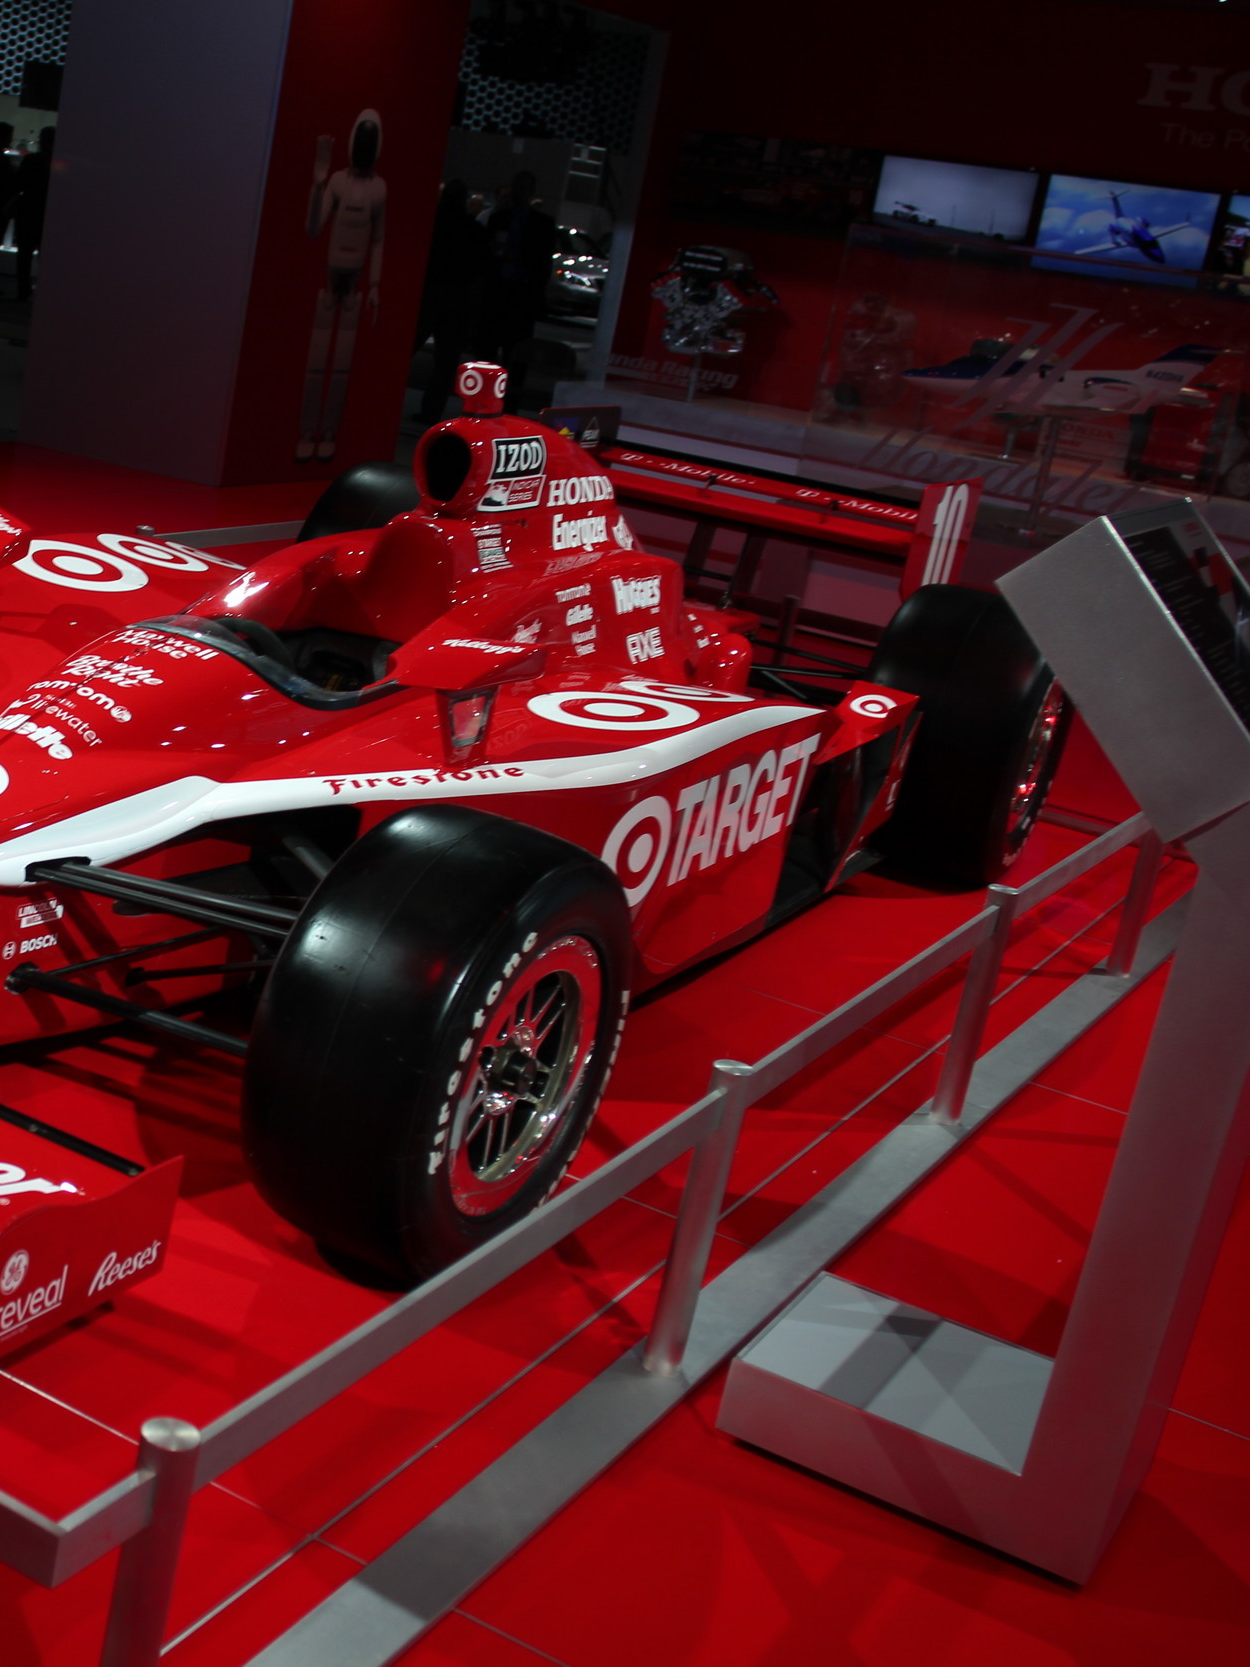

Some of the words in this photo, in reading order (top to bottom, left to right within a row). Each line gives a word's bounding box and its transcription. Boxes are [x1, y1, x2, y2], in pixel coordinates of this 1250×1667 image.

[1160, 121, 1216, 150] The
[495, 441, 543, 473] IZOD
[842, 499, 918, 521] Mobil
[921, 483, 970, 584] 10
[625, 626, 667, 665] AXE
[322, 765, 526, 796] Firestone
[667, 732, 822, 887] TARGET
[19, 932, 59, 954] BOSCH
[427, 931, 540, 1175] Firestone
[86, 1239, 163, 1298] Reese's
